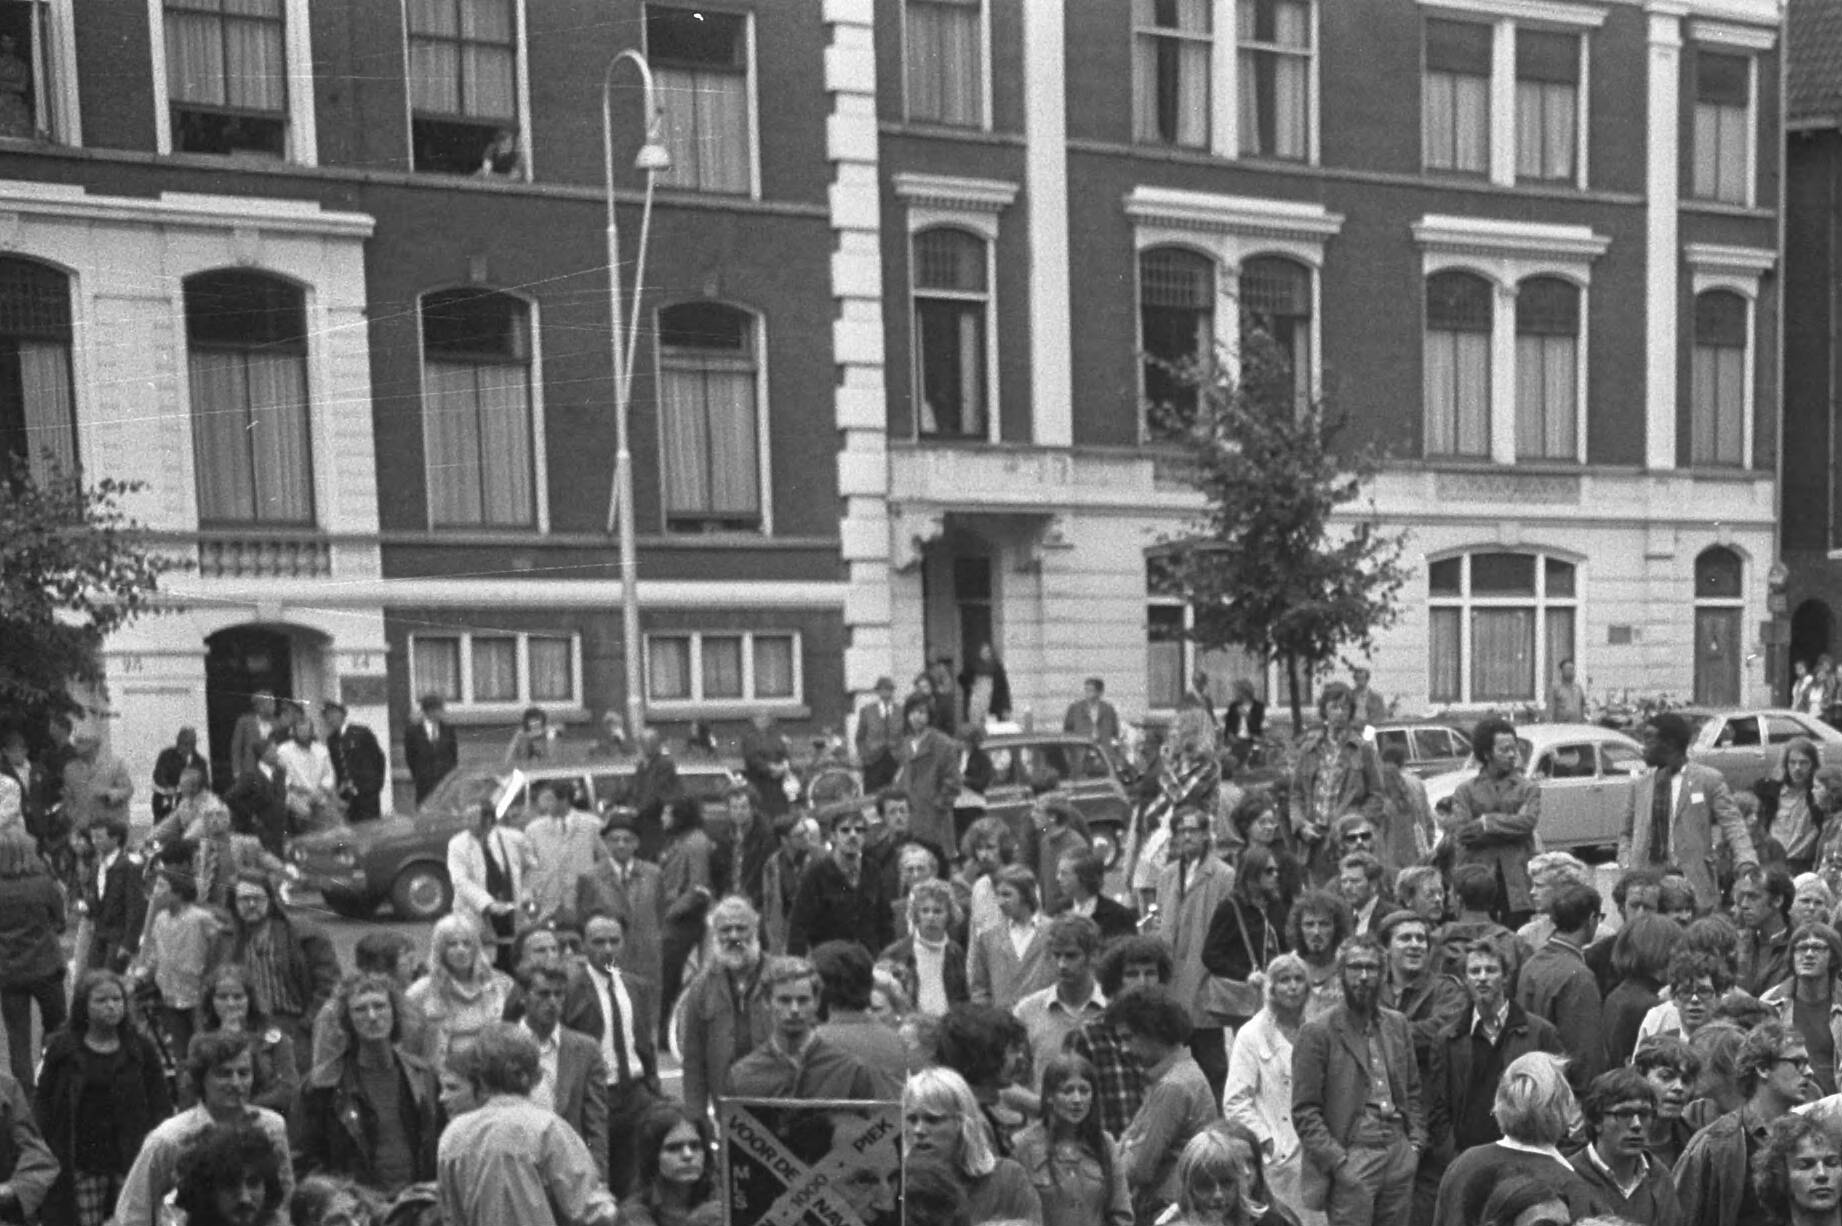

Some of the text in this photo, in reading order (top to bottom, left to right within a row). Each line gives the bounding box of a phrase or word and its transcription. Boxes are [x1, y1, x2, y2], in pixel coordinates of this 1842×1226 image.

[729, 1114, 778, 1162] VOOR
[773, 1158, 802, 1182] DE
[852, 1117, 895, 1155] PIEK
